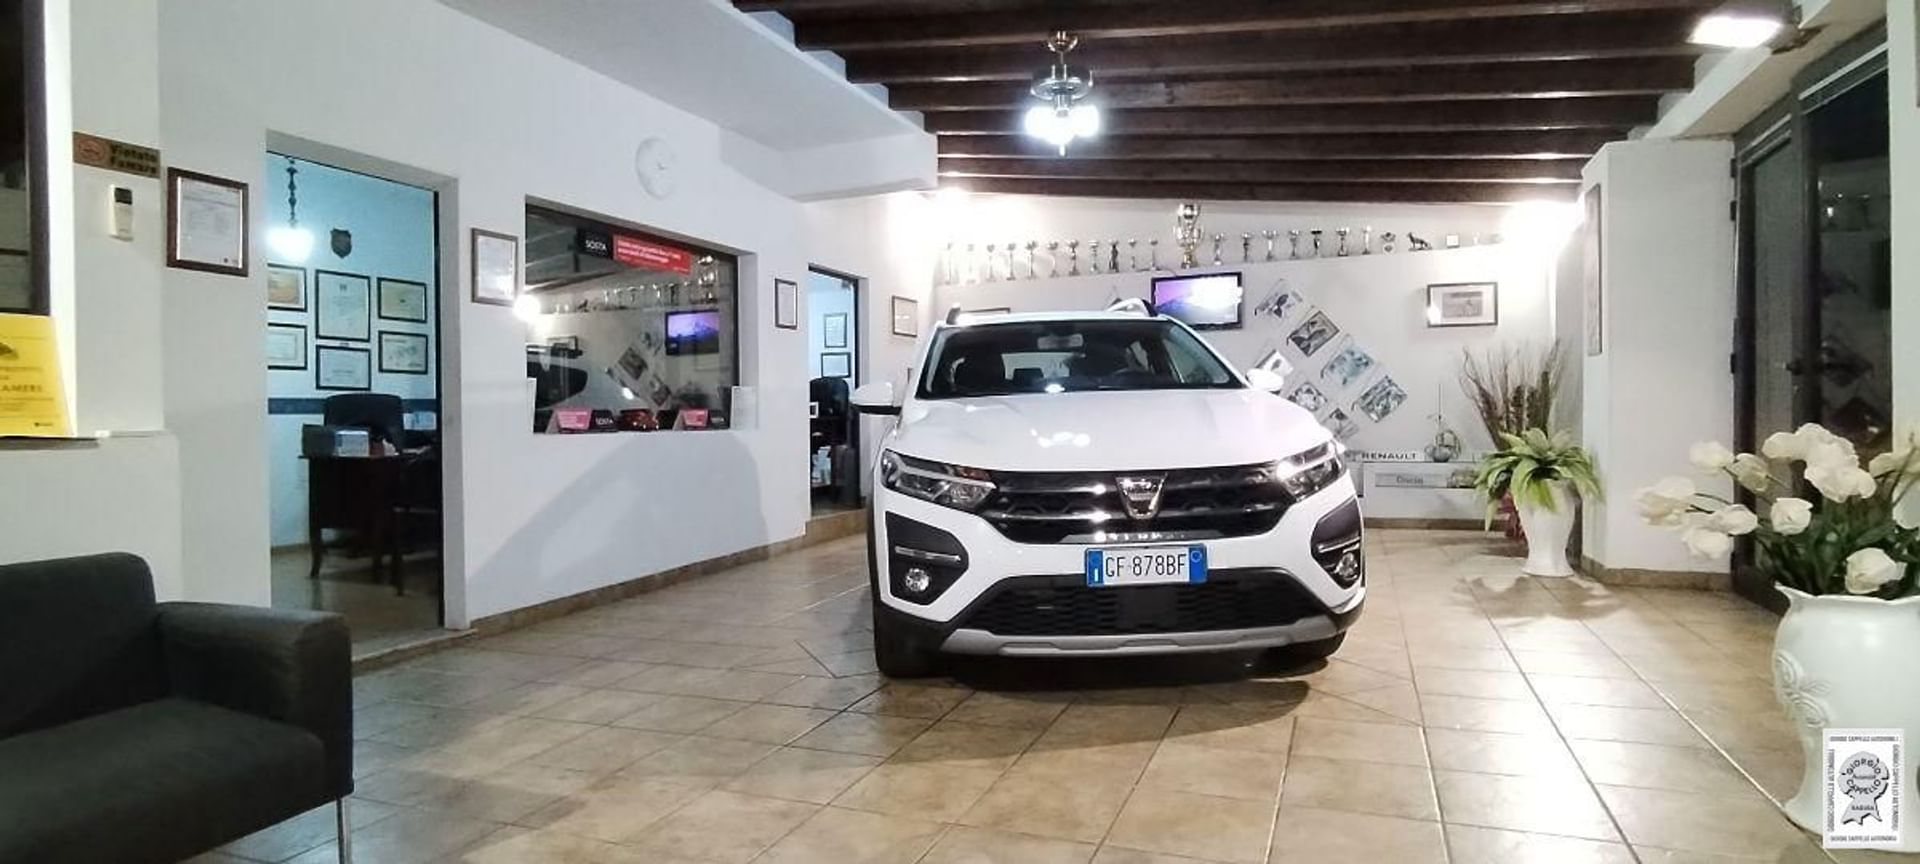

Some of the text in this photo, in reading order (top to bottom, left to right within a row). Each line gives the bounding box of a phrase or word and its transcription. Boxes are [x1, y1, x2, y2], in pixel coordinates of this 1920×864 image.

[1361, 451, 1417, 460] RENAULT
[1104, 553, 1188, 577] GF 878BF
